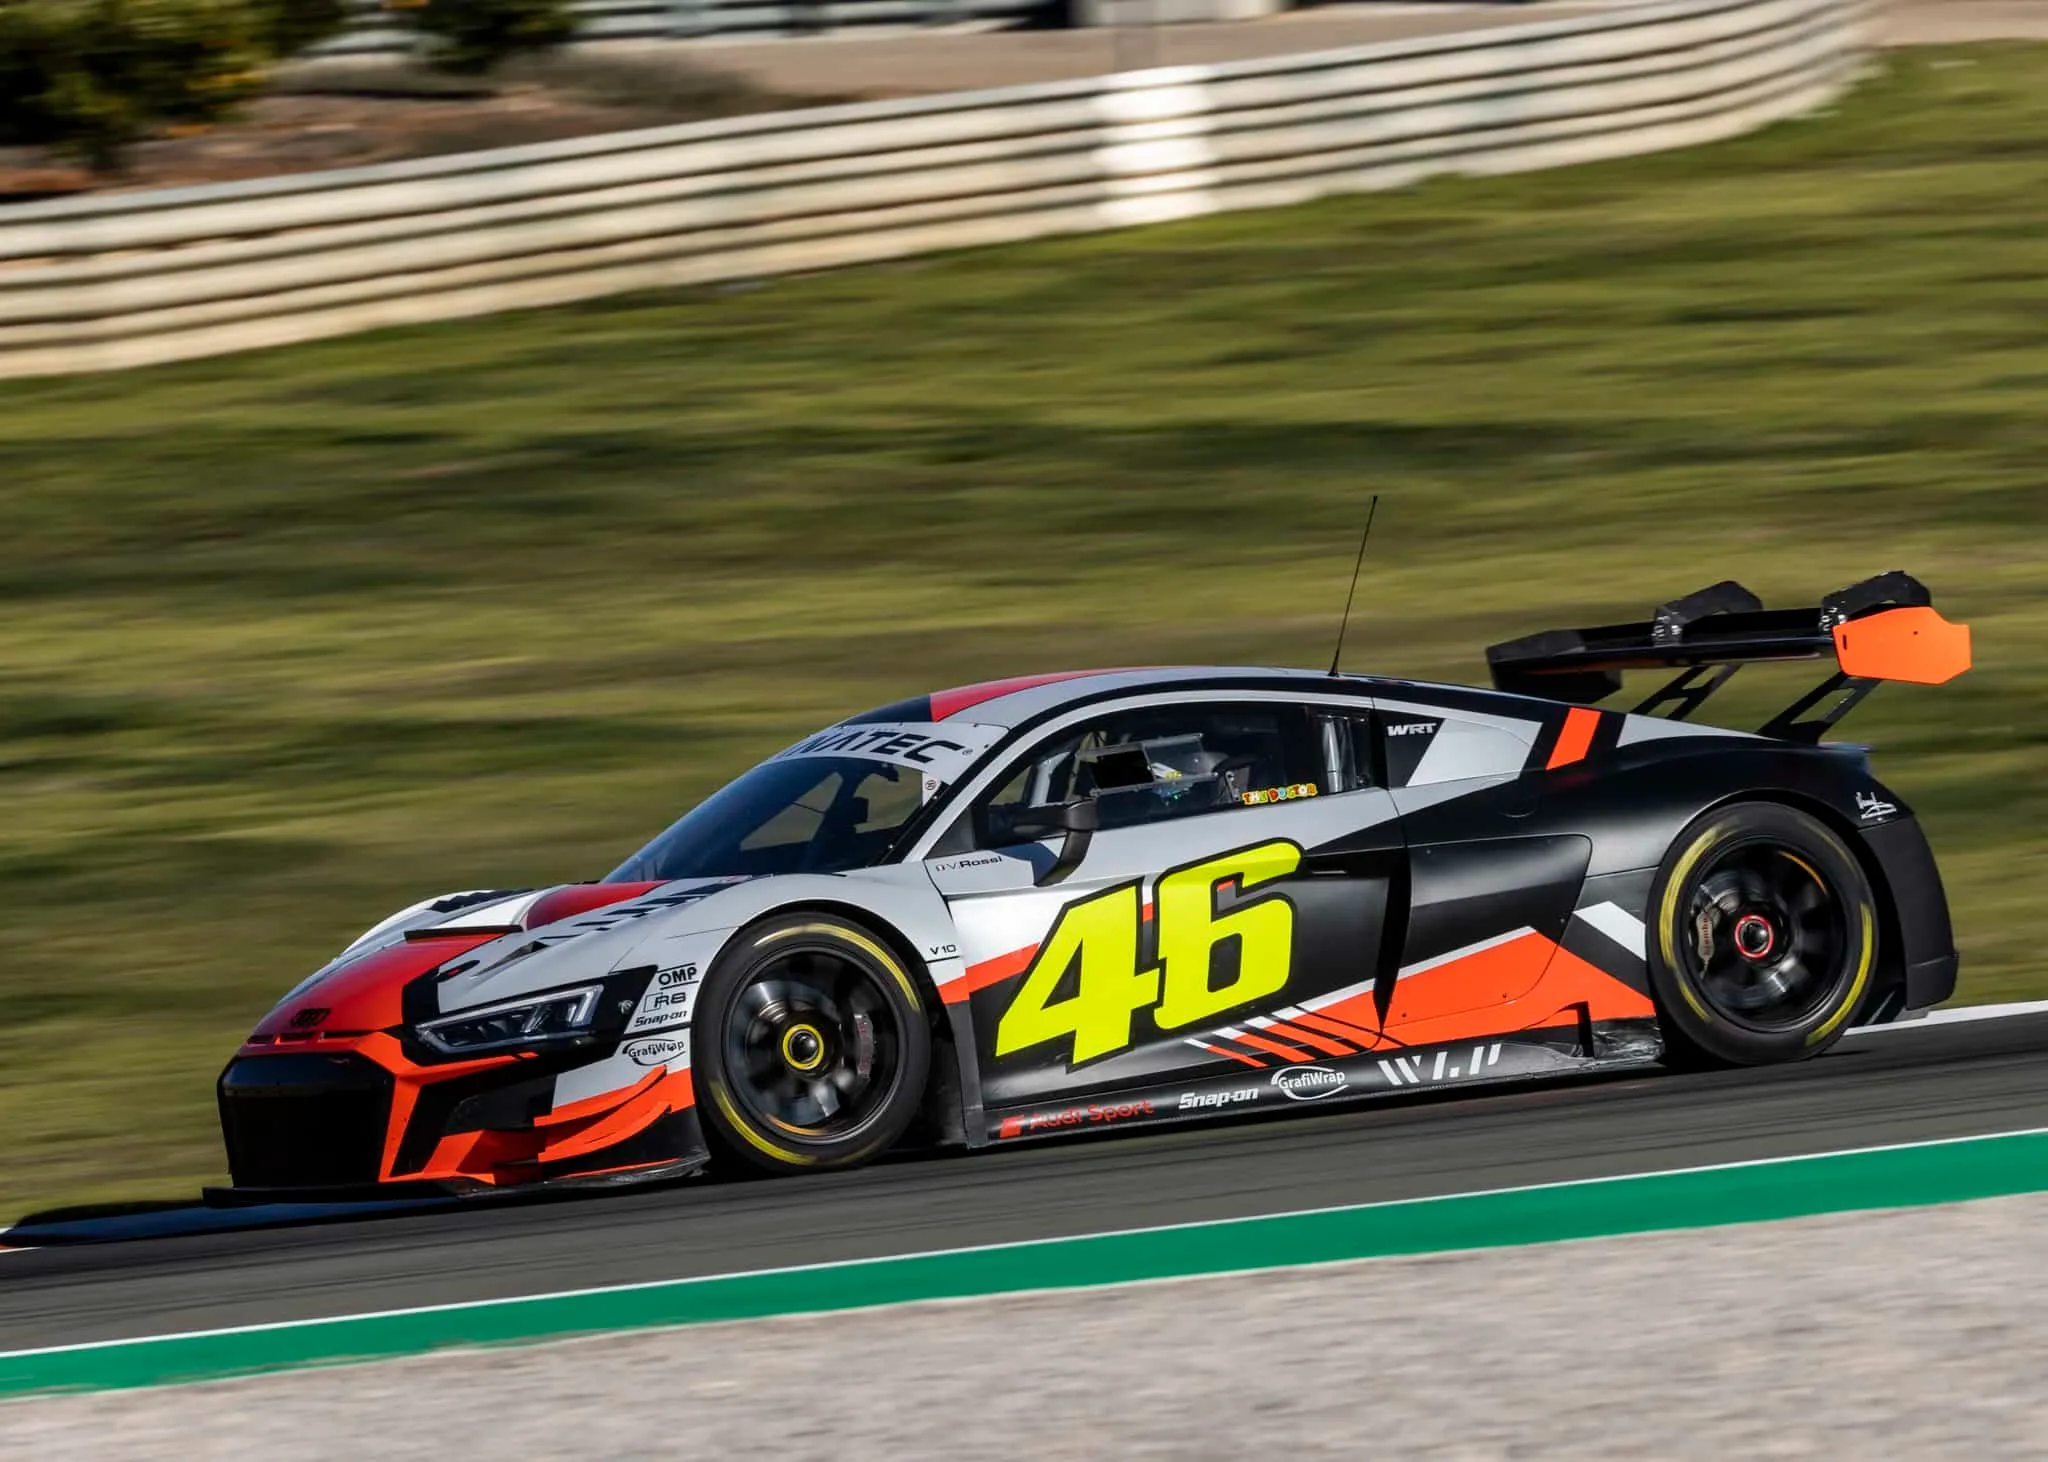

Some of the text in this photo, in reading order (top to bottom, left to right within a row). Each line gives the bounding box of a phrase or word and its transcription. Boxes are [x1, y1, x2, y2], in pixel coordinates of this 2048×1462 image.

[1386, 722, 1437, 737] WRT
[993, 840, 1303, 1068] 46
[658, 966, 698, 985] OMP
[653, 992, 687, 1008] R8
[634, 1010, 688, 1028] Snap-on
[628, 1040, 685, 1058] GrafiWrap
[1278, 1071, 1346, 1089] GrafiWrap
[1178, 1087, 1259, 1110] Snap-on
[1029, 1098, 1155, 1130] Audi Sport
